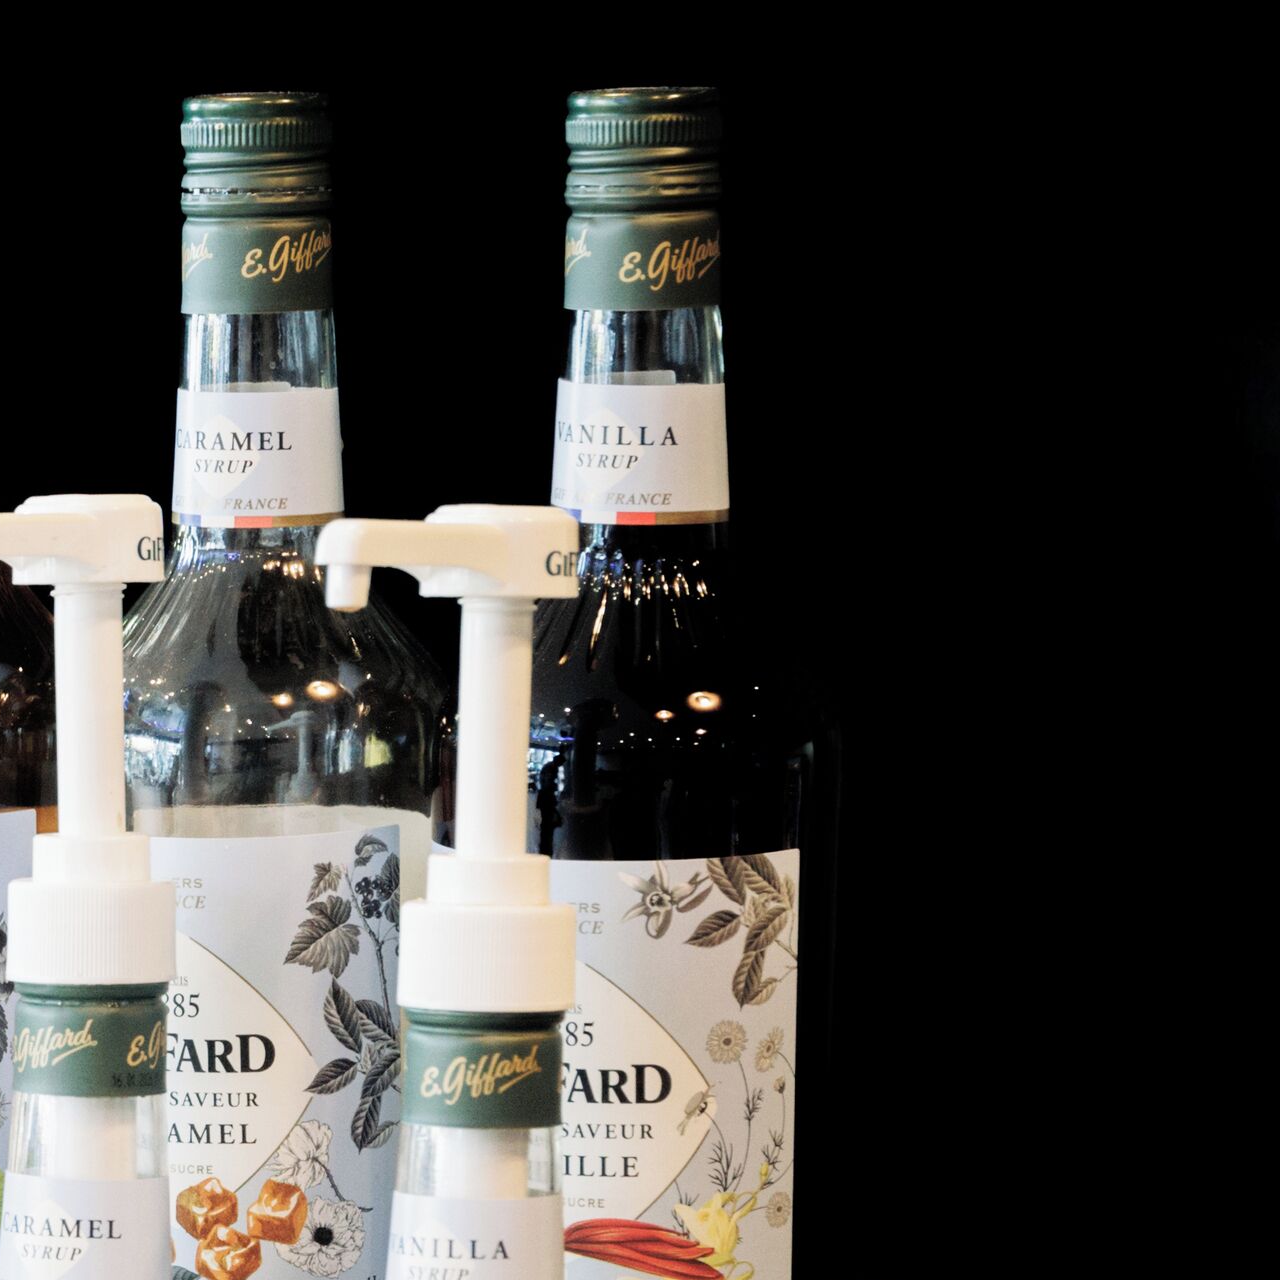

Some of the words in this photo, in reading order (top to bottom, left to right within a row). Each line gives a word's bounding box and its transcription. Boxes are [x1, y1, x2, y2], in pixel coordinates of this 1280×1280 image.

[176, 429, 292, 451] CARAMEL
[558, 421, 679, 446] VANILLA
[194, 459, 253, 473] SYRUP
[576, 453, 638, 469] SYRUP
[169, 1091, 259, 1108] SAVEUR
[168, 1122, 257, 1145] AMEL
[562, 1154, 639, 1177] ILLE
[567, 1197, 605, 1208] UCRE
[2, 1212, 122, 1239] CARAMEL
[21, 1244, 82, 1261] SYRUP
